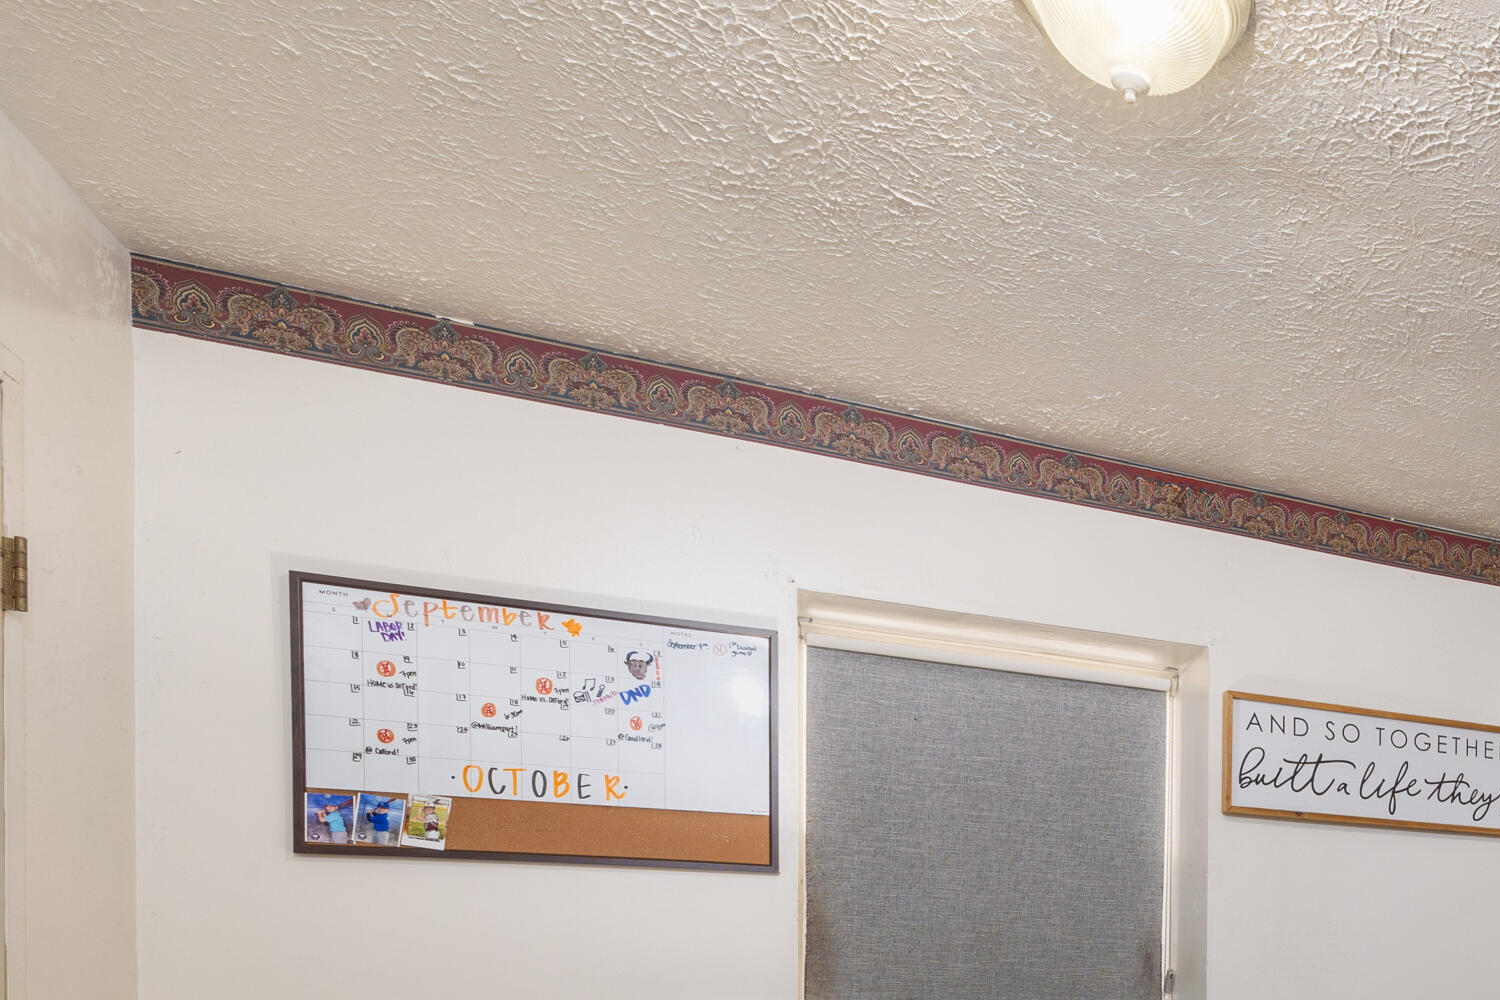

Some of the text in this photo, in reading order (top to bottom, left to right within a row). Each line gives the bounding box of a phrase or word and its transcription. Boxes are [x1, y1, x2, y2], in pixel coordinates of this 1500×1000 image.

[318, 589, 349, 597] MONTH
[618, 684, 651, 706] DND
[1245, 712, 1309, 738] AND
[1324, 720, 1361, 745] SO
[462, 764, 626, 801] OCTOBER
[1238, 746, 1357, 797] built
[1336, 780, 1351, 796] a
[1359, 761, 1422, 815] life
